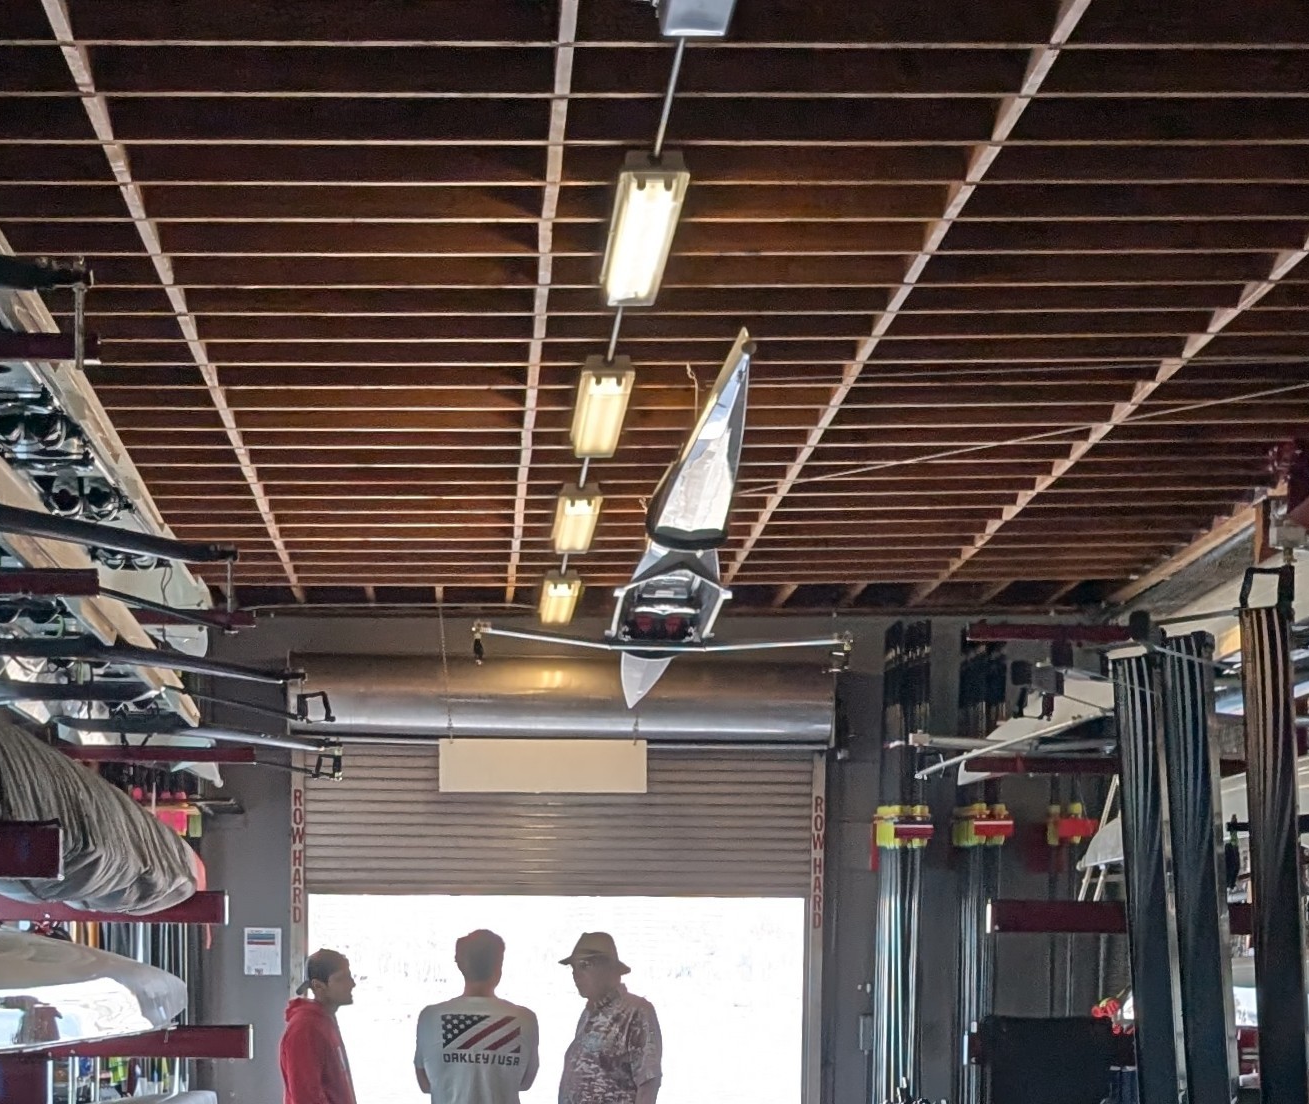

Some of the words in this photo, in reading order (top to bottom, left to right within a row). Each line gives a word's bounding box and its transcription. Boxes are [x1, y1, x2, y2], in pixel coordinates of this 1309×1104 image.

[292, 788, 305, 845] ROW
[812, 795, 824, 850] ROW
[292, 849, 303, 924] HARD
[812, 857, 823, 929] HARD
